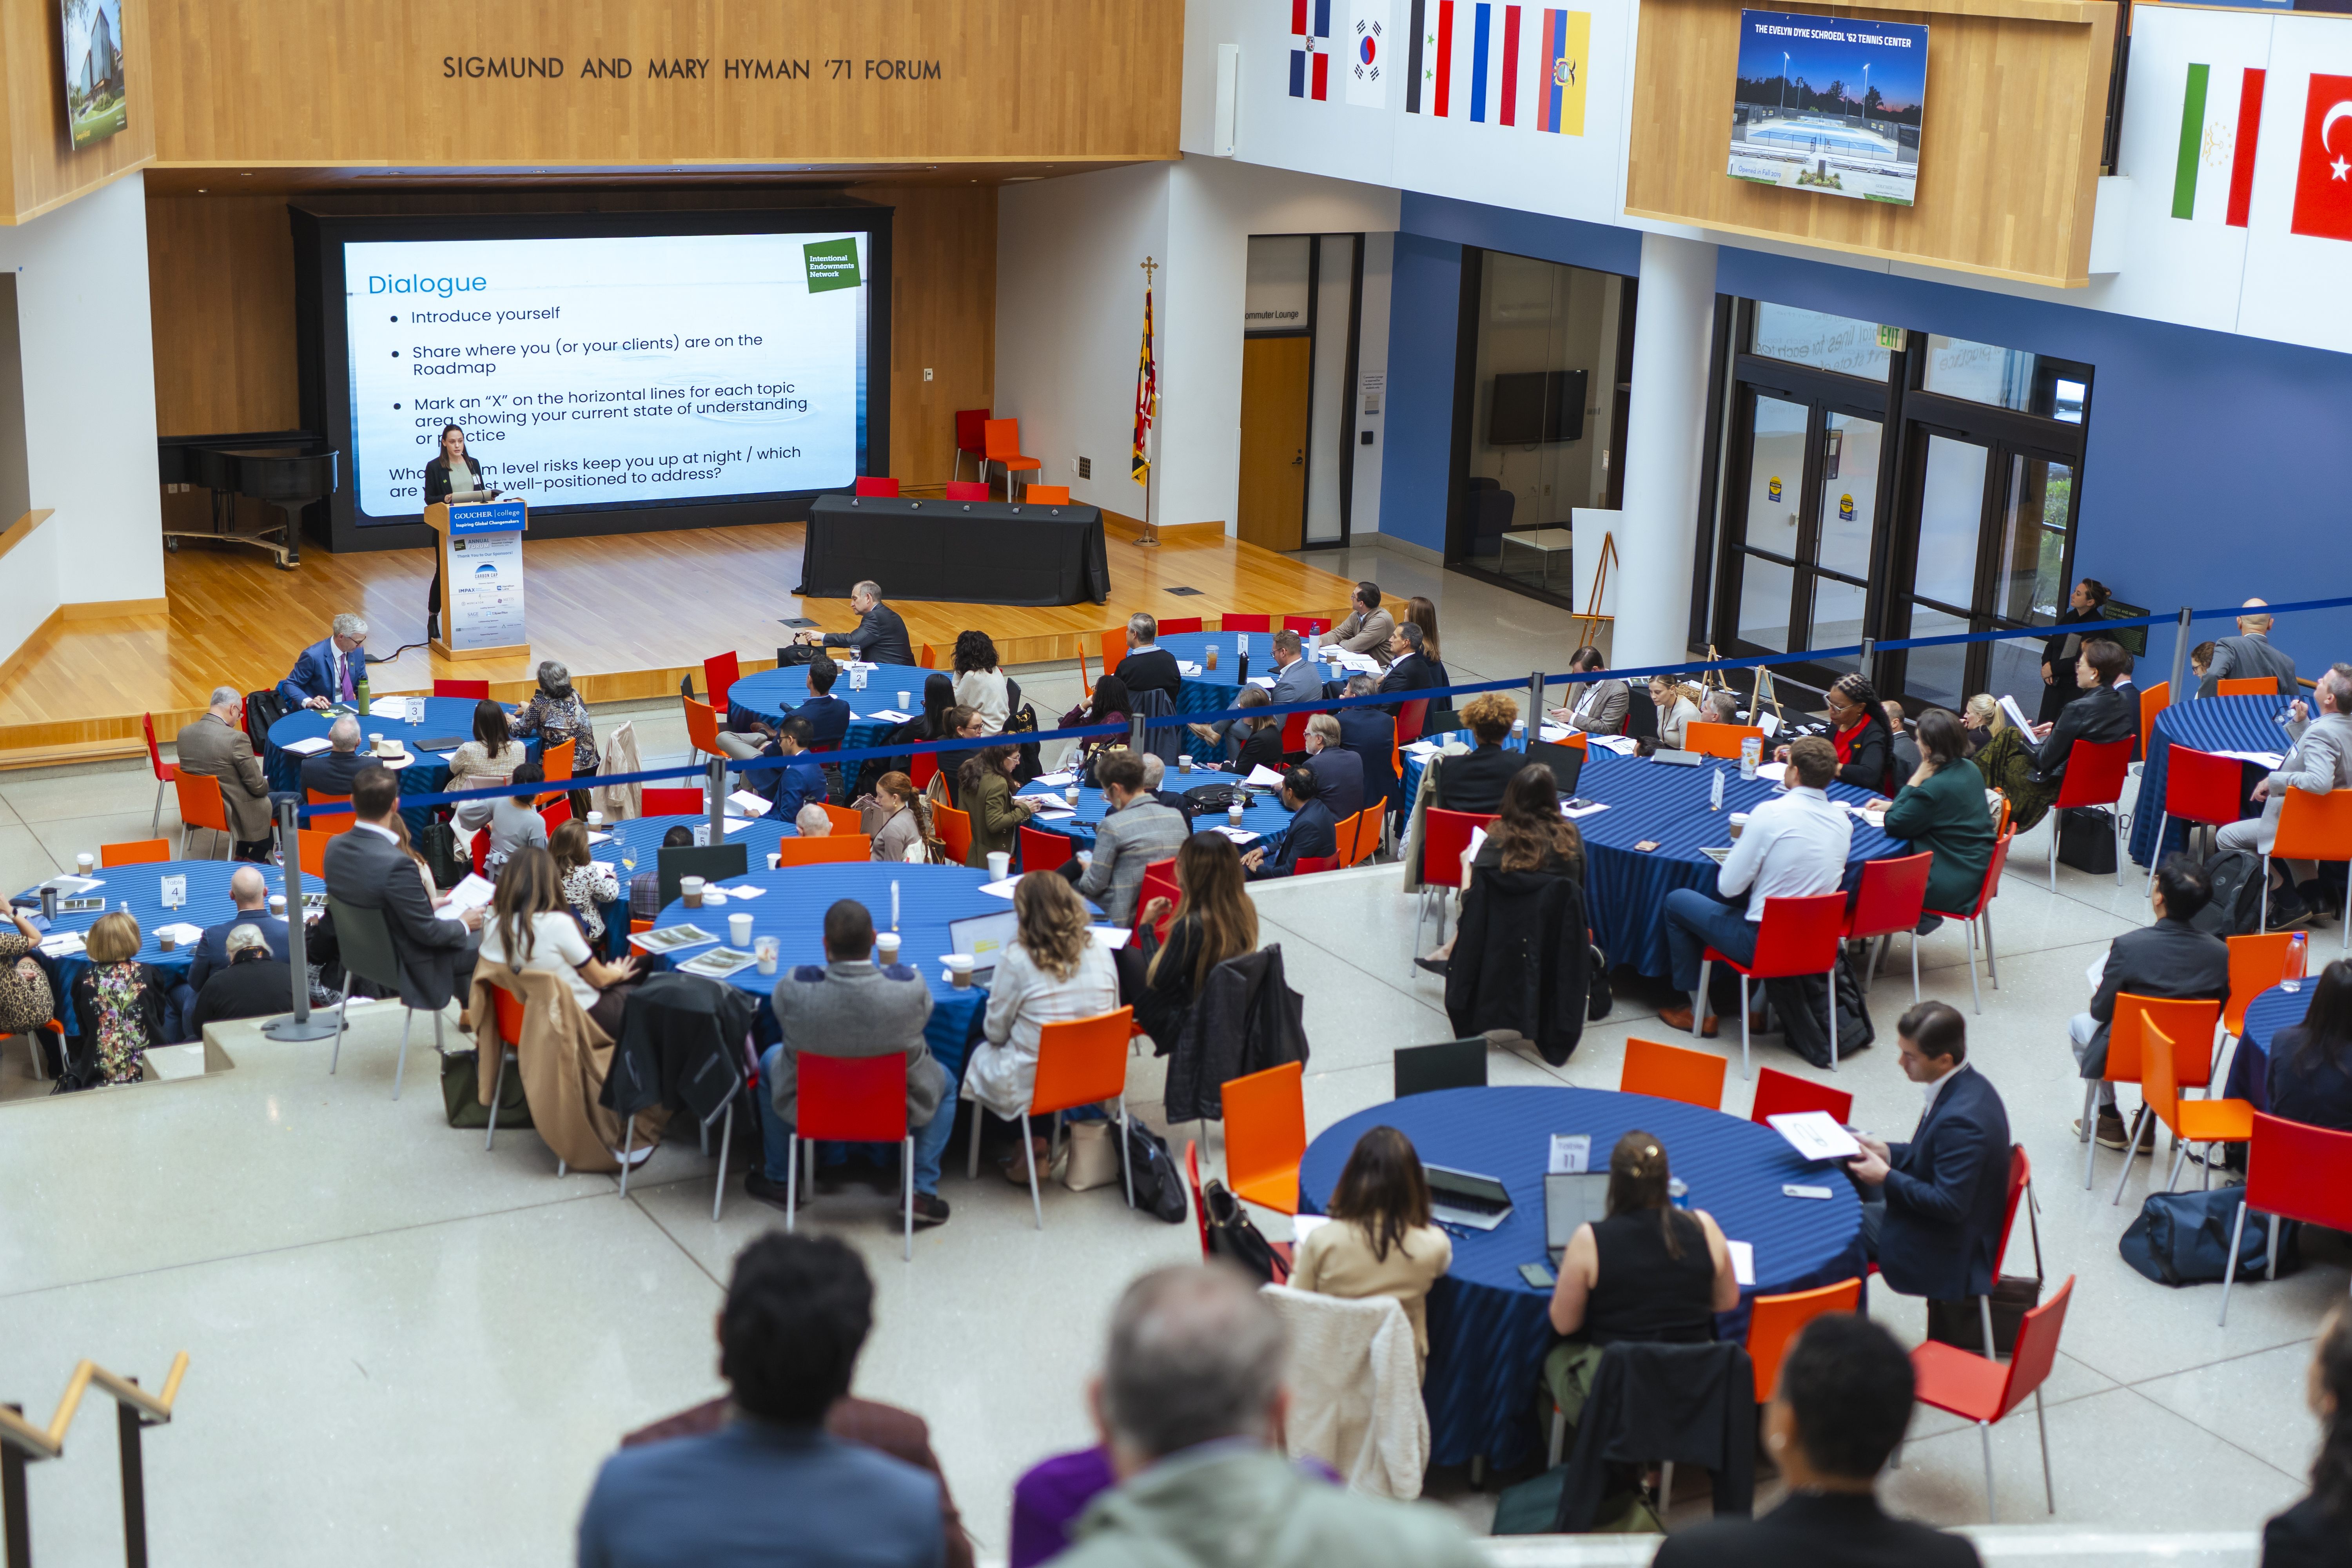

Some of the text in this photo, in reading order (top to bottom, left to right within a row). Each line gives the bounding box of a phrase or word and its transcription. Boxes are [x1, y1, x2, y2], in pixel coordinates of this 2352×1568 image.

[1755, 24, 1911, 48] THE EVELYN DYKE SCHROEDL '62 TENNIS CENTER
[443, 56, 942, 80] SIGMUND AND MARY HYMAN '71 FORUM
[1739, 165, 1757, 174] Opened
[369, 274, 487, 299] Dialogue
[412, 306, 560, 325] Introduce yourself
[1245, 310, 1299, 319] ommuter Lounge
[413, 334, 763, 358] Share where you (or your clients) are on the
[1881, 325, 1900, 348] EXIT
[414, 361, 496, 377] Roadmap
[415, 381, 795, 410] Mark an “X” on the horizontal lines for each topic
[415, 397, 807, 428] area showing your current state of understanding
[416, 434, 433, 445] or
[388, 467, 426, 481] Wha
[503, 460, 539, 474] level
[544, 459, 578, 472] risks
[583, 457, 621, 472] keep
[625, 457, 654, 471] you
[659, 456, 679, 469] up
[682, 452, 699, 464] at
[703, 450, 742, 466] night
[746, 445, 753, 463] /
[756, 446, 801, 460] which
[390, 487, 418, 498] are
[503, 472, 627, 492] well-positioned
[631, 472, 647, 483] to
[651, 467, 722, 482] address?
[454, 511, 493, 519] GOUCHER
[700, 837, 705, 846] 5
[171, 887, 179, 896] 4
[1564, 1154, 1575, 1169] 11
